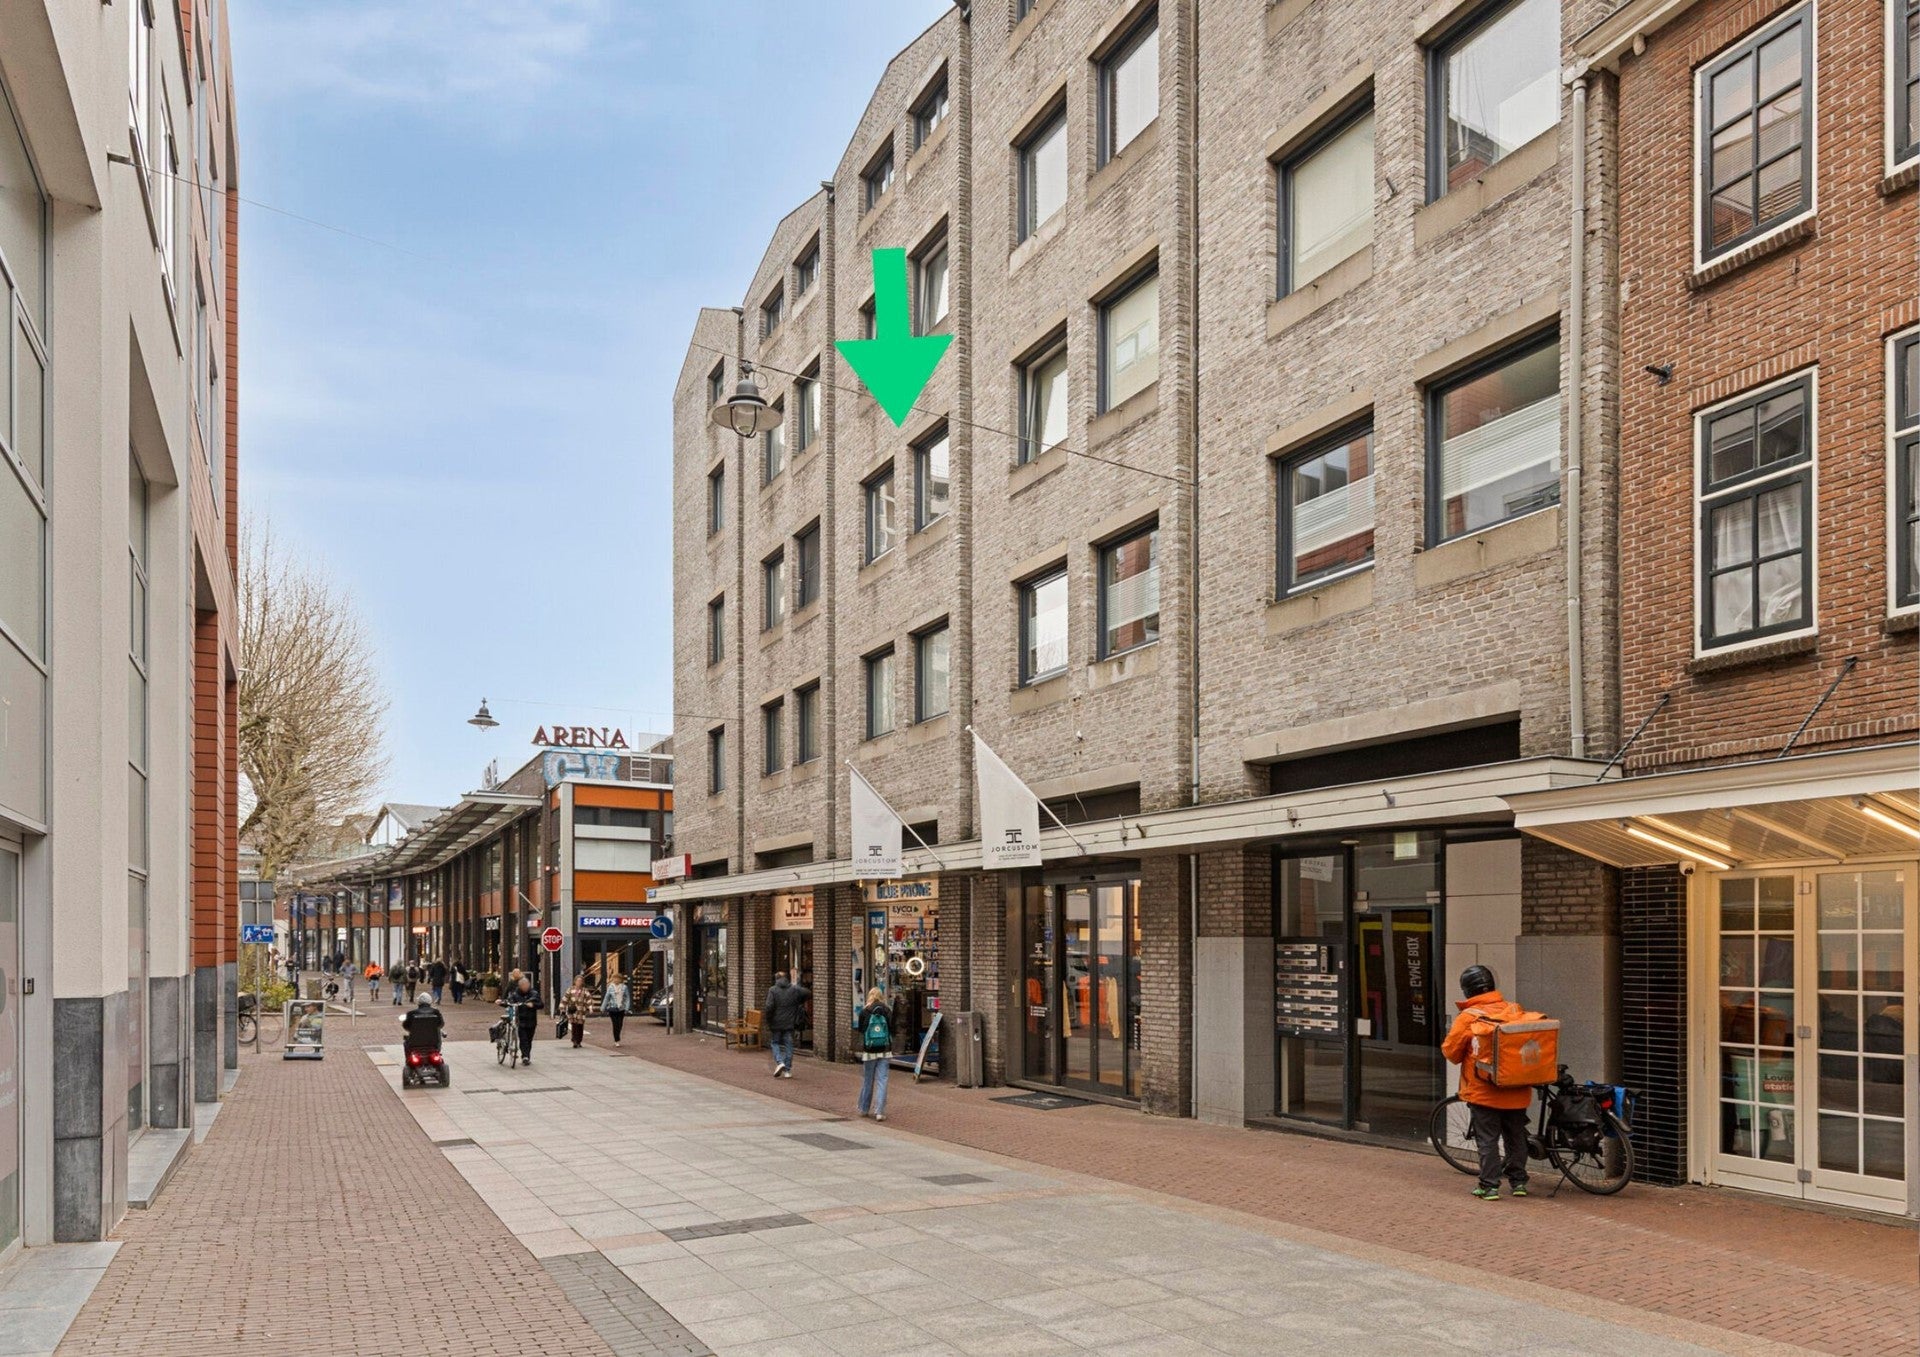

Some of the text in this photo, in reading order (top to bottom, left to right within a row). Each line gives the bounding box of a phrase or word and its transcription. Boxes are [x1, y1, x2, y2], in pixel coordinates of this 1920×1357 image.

[531, 725, 630, 749] ARENA
[991, 844, 1038, 853] JORCUSTOM
[900, 882, 932, 897] PHONE
[583, 918, 653, 926] SPORTS DIRECT
[544, 935, 563, 944] STOP
